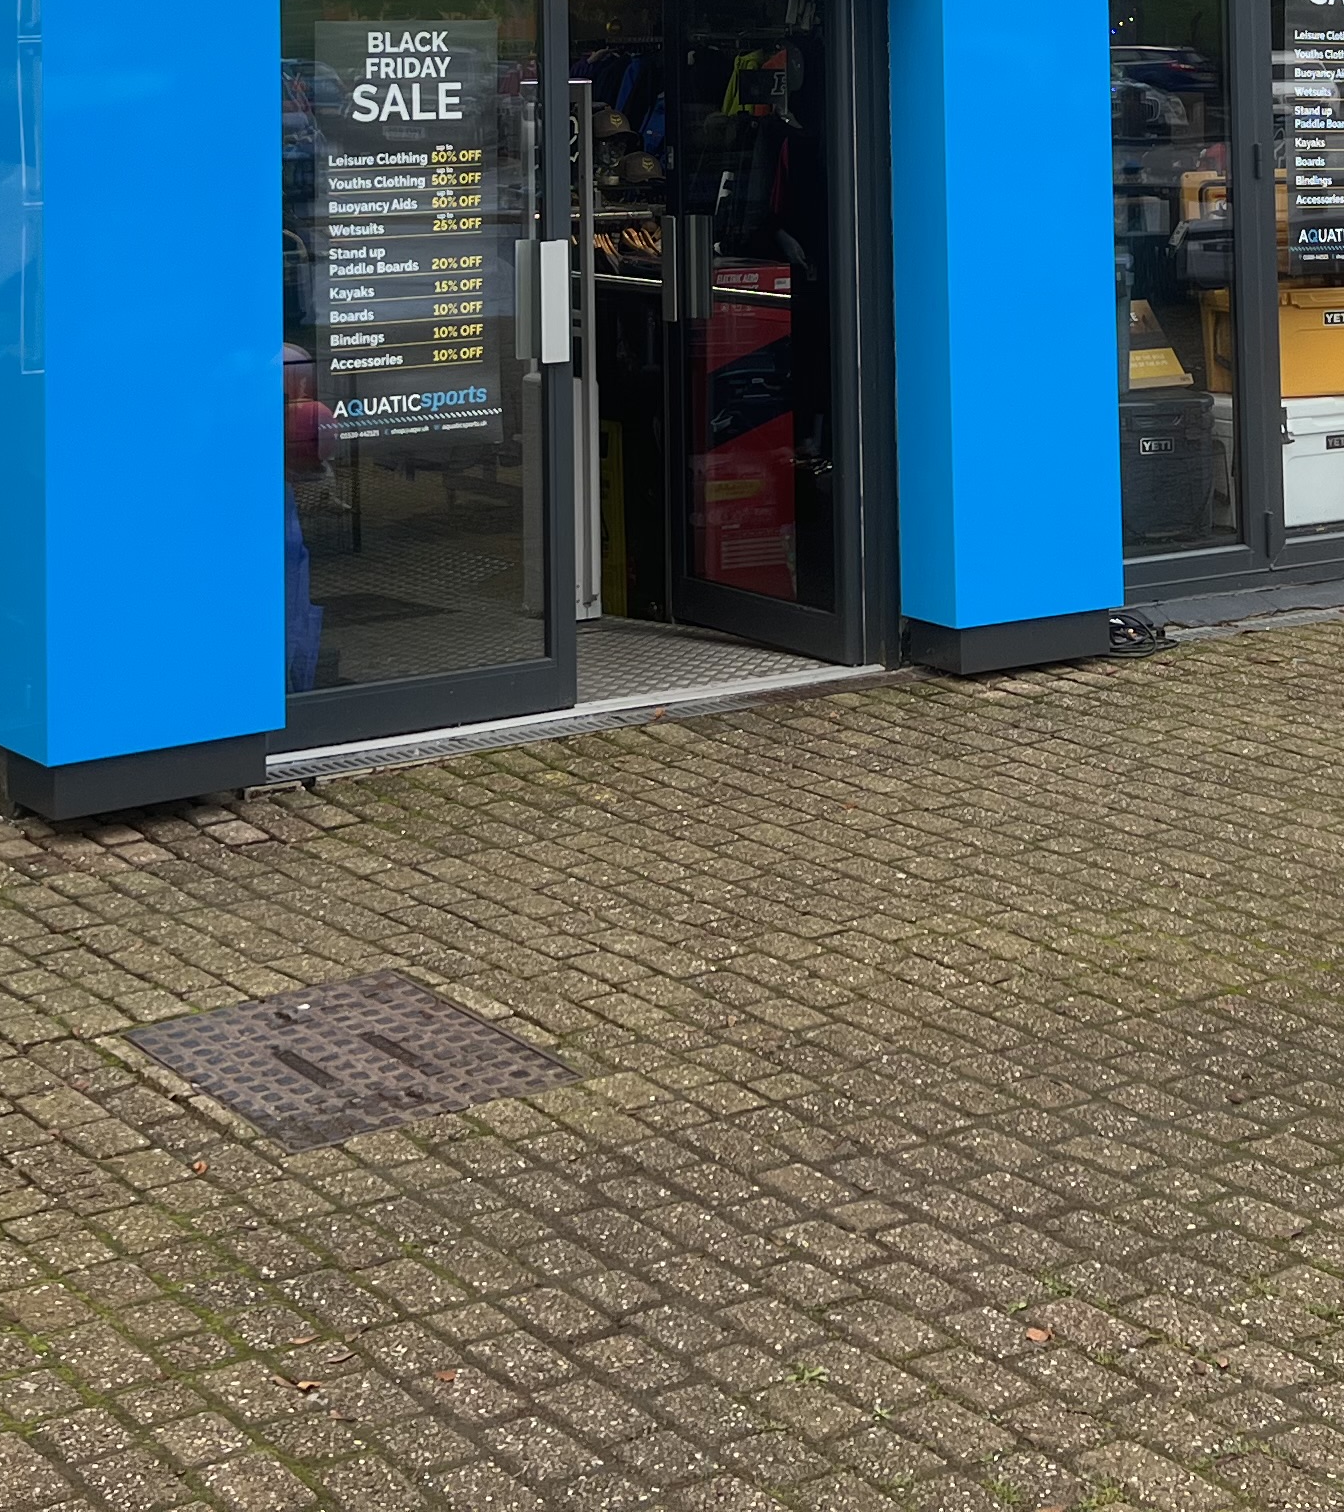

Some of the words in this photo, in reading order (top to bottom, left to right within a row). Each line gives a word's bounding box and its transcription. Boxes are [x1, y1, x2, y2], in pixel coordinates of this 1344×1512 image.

[367, 31, 449, 53] BLACK
[1294, 30, 1325, 41] Leisure
[1294, 49, 1323, 59] Youths
[365, 56, 451, 79] FRIDAY
[1294, 68, 1334, 80] Buoyancy
[1294, 87, 1332, 97] Wetsuits
[352, 82, 463, 122] SALE
[1295, 106, 1320, 116] Stand
[1321, 108, 1332, 117] up
[1295, 119, 1324, 129] Paddle
[1295, 137, 1326, 150] Kayaks
[328, 155, 374, 167] Leisure
[376, 152, 428, 168] Clothing
[431, 151, 457, 163] 50%
[459, 150, 482, 161] OFF
[1295, 156, 1325, 166] Boards
[328, 178, 372, 190] Youths
[374, 175, 426, 189] Clothing
[431, 174, 457, 186] 50%
[459, 172, 482, 184] OFF
[1295, 176, 1332, 187] Bindings
[328, 200, 390, 215] Buoyancy
[391, 198, 418, 211] Aids
[431, 196, 457, 209] 50%
[459, 195, 481, 207] OFF
[1296, 194, 1344, 205] Accessories
[329, 223, 385, 237] Wetsuits
[433, 219, 457, 232] 25%
[459, 218, 482, 230] OFF
[329, 247, 367, 260] Stand
[369, 248, 386, 260] up
[329, 263, 374, 276] Paddle
[376, 260, 419, 274] Boards
[431, 257, 458, 270] 20%
[460, 255, 482, 268] OFF
[329, 286, 375, 302] Kayaks
[434, 280, 458, 293] 15%
[460, 278, 483, 291] OFF
[330, 309, 374, 323] Boards
[433, 303, 458, 316] 10%
[460, 301, 483, 313] OFF
[330, 332, 385, 347] Bindings
[433, 325, 458, 339] 10%
[460, 324, 483, 336] OFF
[330, 354, 403, 371] Accessories
[433, 348, 458, 362] 10%
[460, 346, 483, 359] OFF
[332, 385, 487, 419] AQUATICsports
[1142, 440, 1171, 452] YETI
